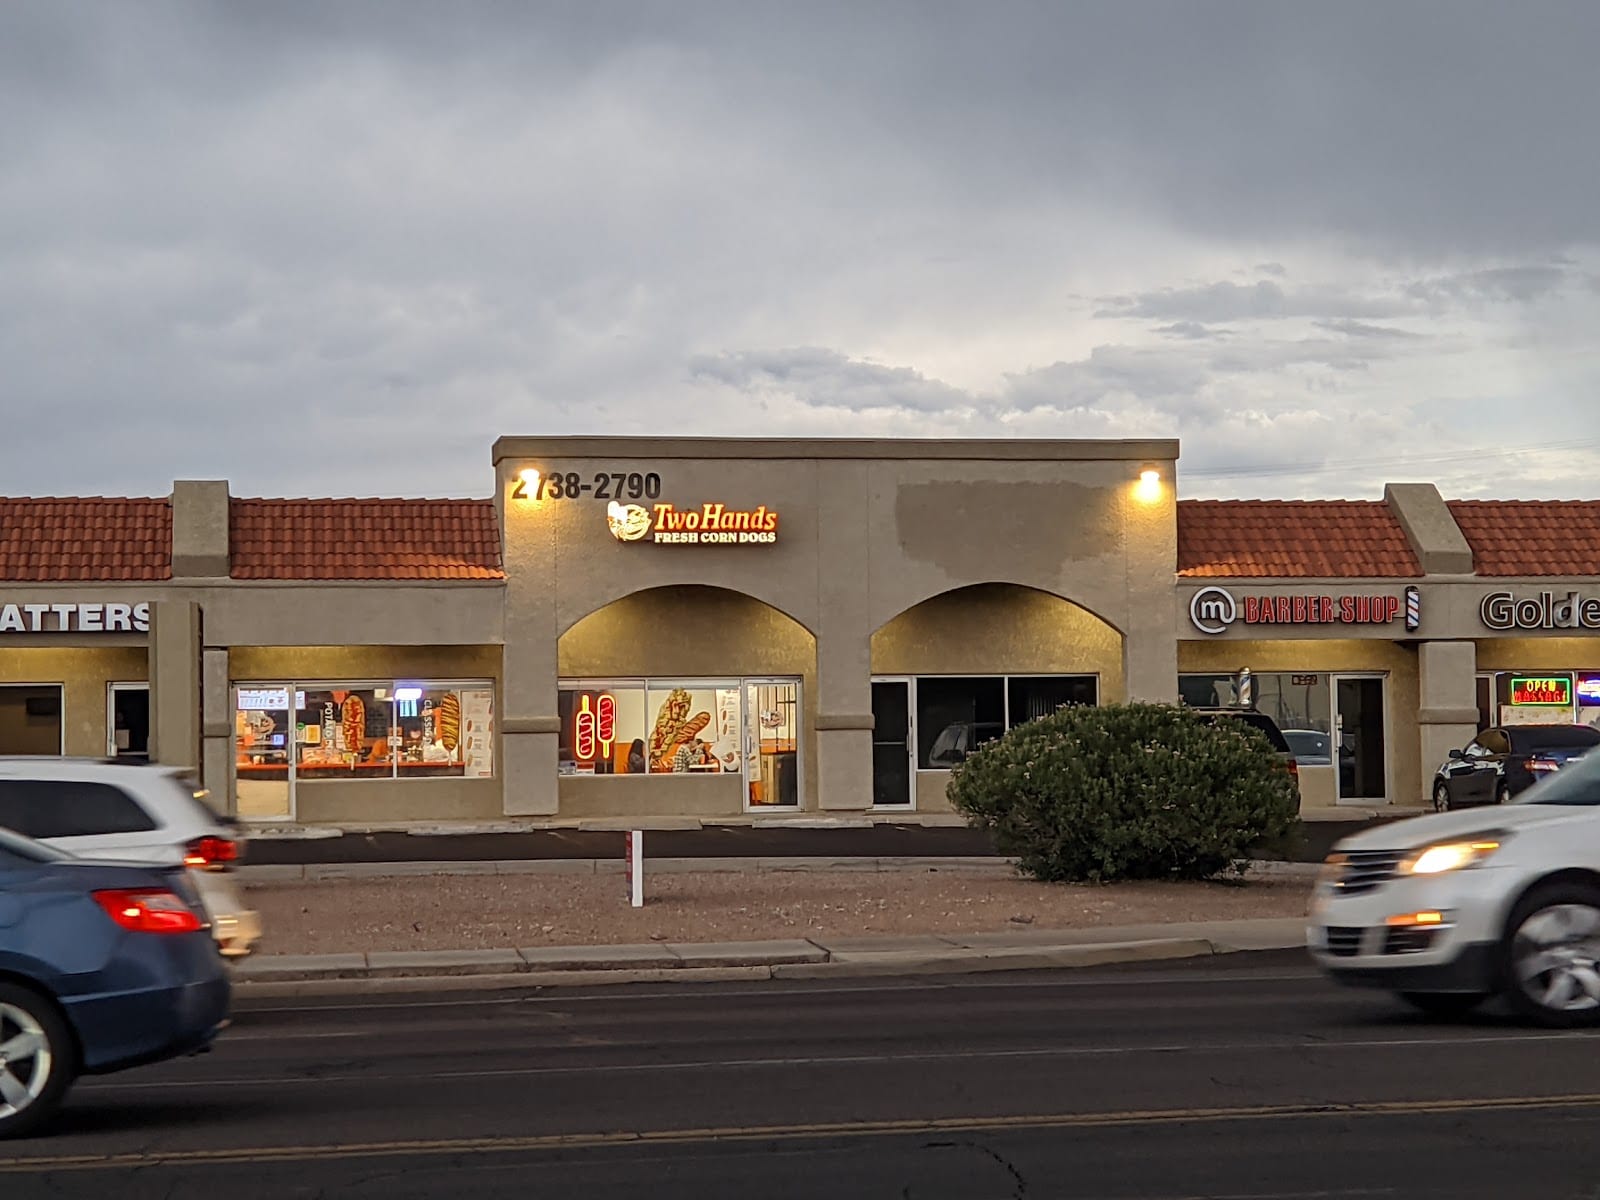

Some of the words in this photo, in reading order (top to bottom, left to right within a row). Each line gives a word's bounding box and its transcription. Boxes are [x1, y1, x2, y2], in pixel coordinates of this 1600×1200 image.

[654, 503, 699, 530] Two
[699, 503, 777, 530] Hands
[654, 532, 698, 543] FRESH
[700, 532, 737, 543] CORN
[739, 532, 776, 543] DOGS
[1244, 596, 1334, 624] BARBER
[1340, 596, 1400, 624] SHOP
[1480, 592, 1600, 629] Golde
[1526, 680, 1557, 692] OPEN
